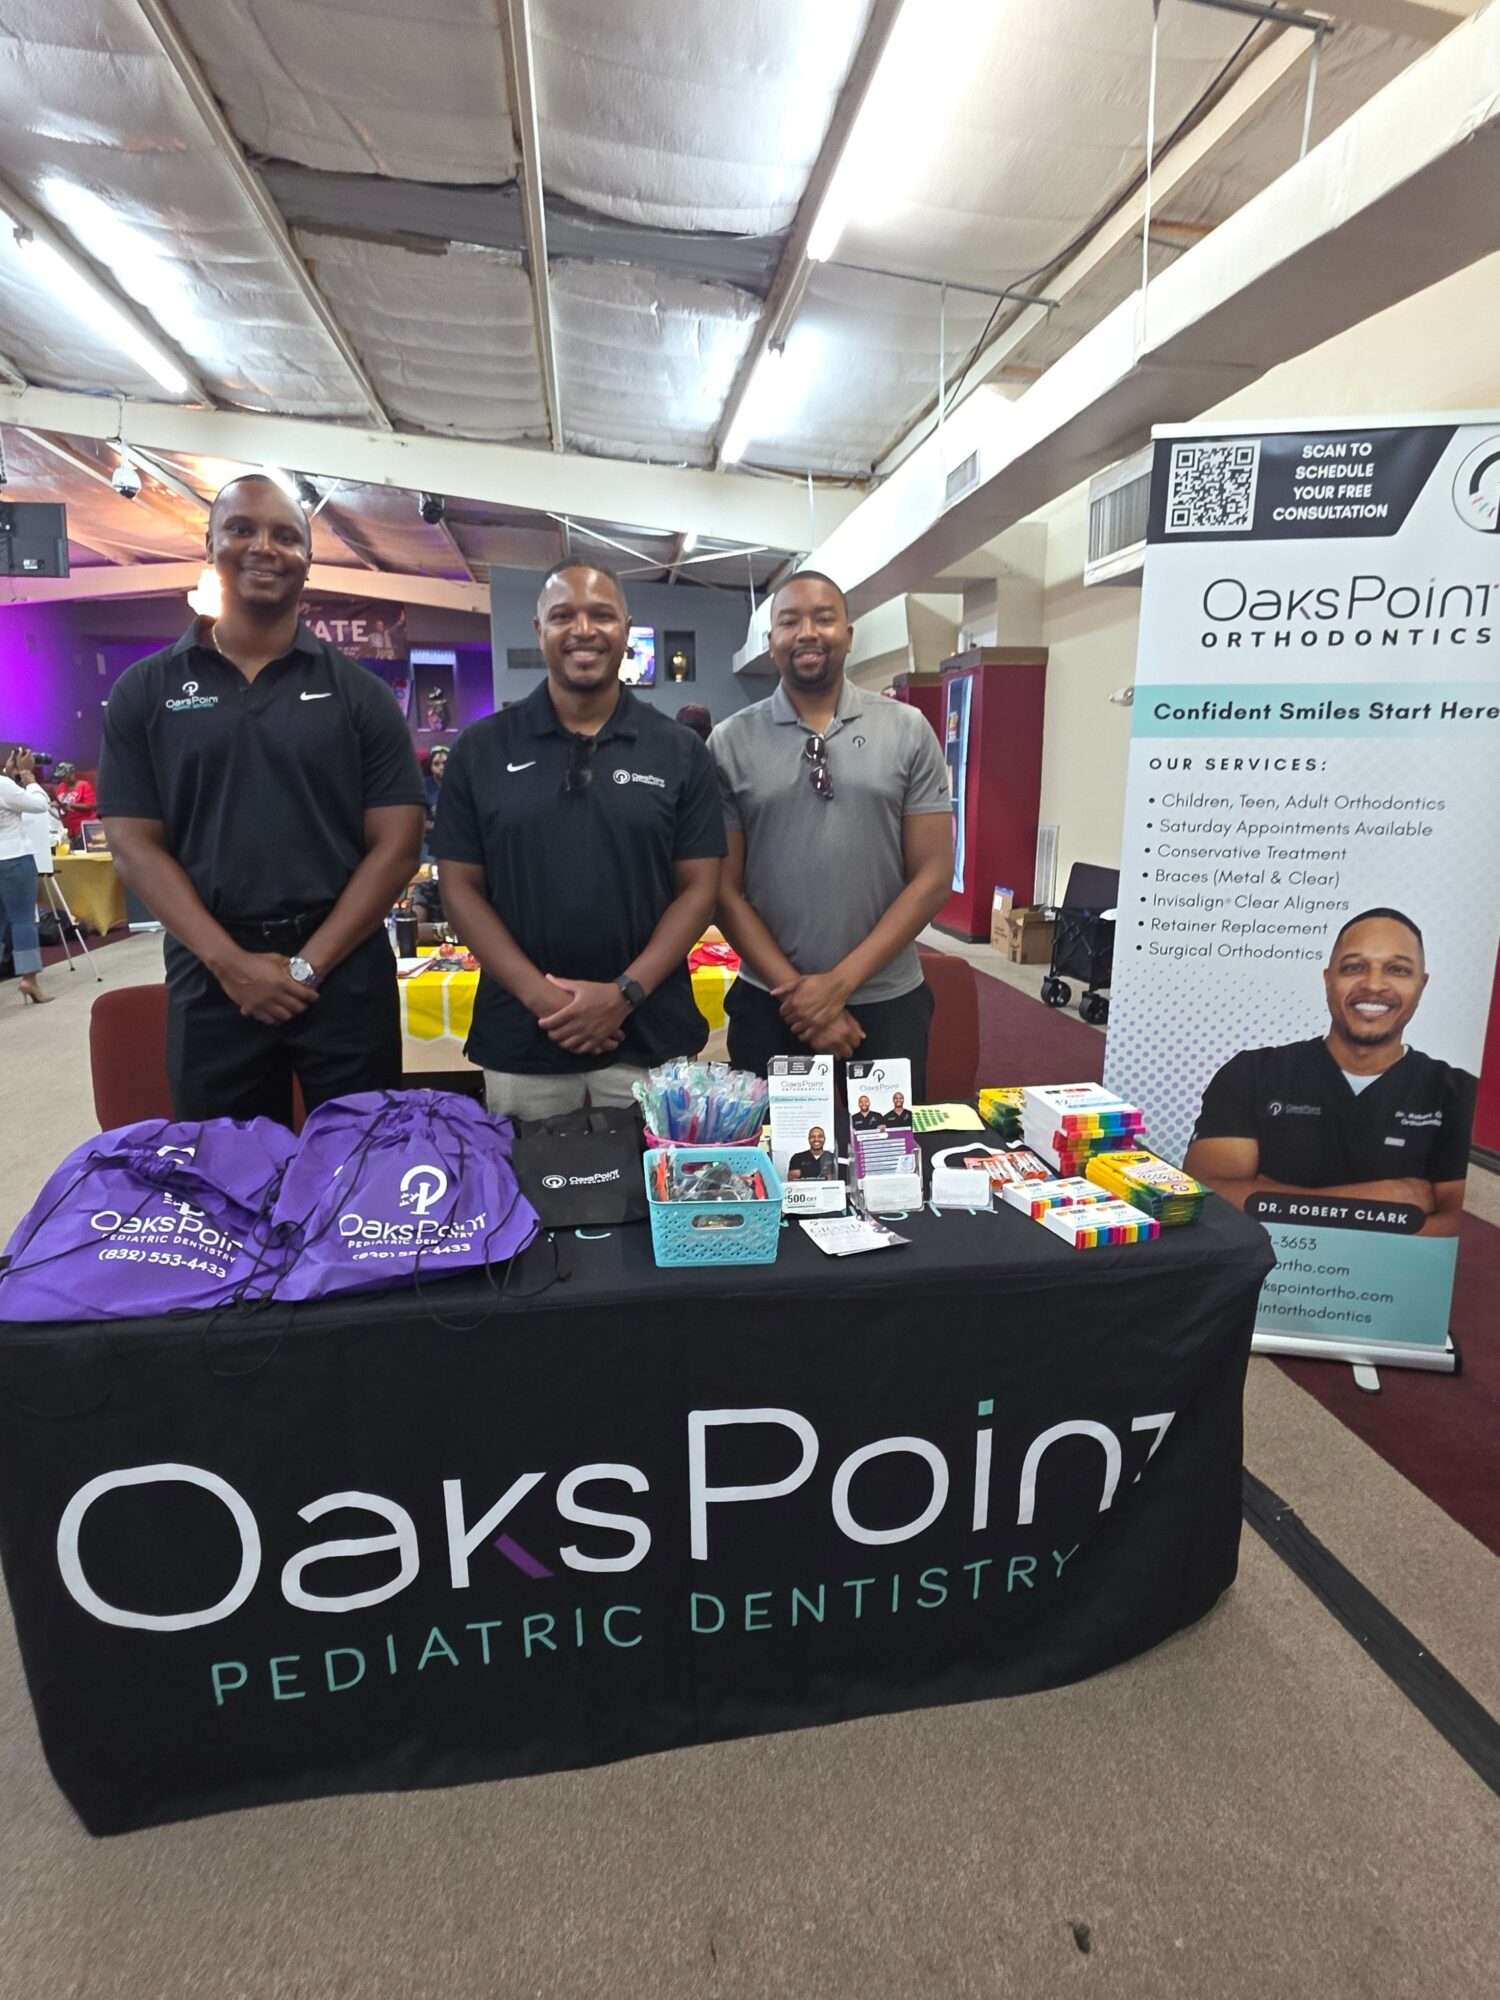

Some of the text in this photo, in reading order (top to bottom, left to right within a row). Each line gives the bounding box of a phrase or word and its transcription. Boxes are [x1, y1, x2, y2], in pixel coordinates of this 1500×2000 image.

[1302, 443, 1372, 459] SCAN TO
[1295, 463, 1375, 480] SCHEDULE
[1293, 484, 1372, 500] YOUR FREE
[1272, 504, 1388, 521] CONSULTATION
[305, 619, 369, 642] ATE
[1201, 627, 1492, 649] ORTHODONTICS
[1153, 701, 1500, 720] Confident Smiles Start Here
[1149, 757, 1328, 772] OUR SERVICES:
[1161, 793, 1446, 811] Children, Teen, Adult Orthodontics
[1159, 818, 1433, 838] Saturday Appointments Available
[1157, 844, 1347, 861] Conservative Treatment
[1155, 869, 1340, 888] Braces (Metal & Clear)
[1234, 894, 1280, 910] Clear
[1284, 896, 1350, 914] Aligners
[1150, 917, 1328, 937] Retainer Replacement
[1148, 941, 1323, 961] Surgical Orthodontics
[1257, 1202, 1410, 1225] DR. ROBERT CLARK
[173, 1235, 237, 1264] DENTISTRY
[98, 1248, 227, 1279] (832) 553-4433
[209, 1543, 1080, 1706] PEDIATRIC DENTISTRY
